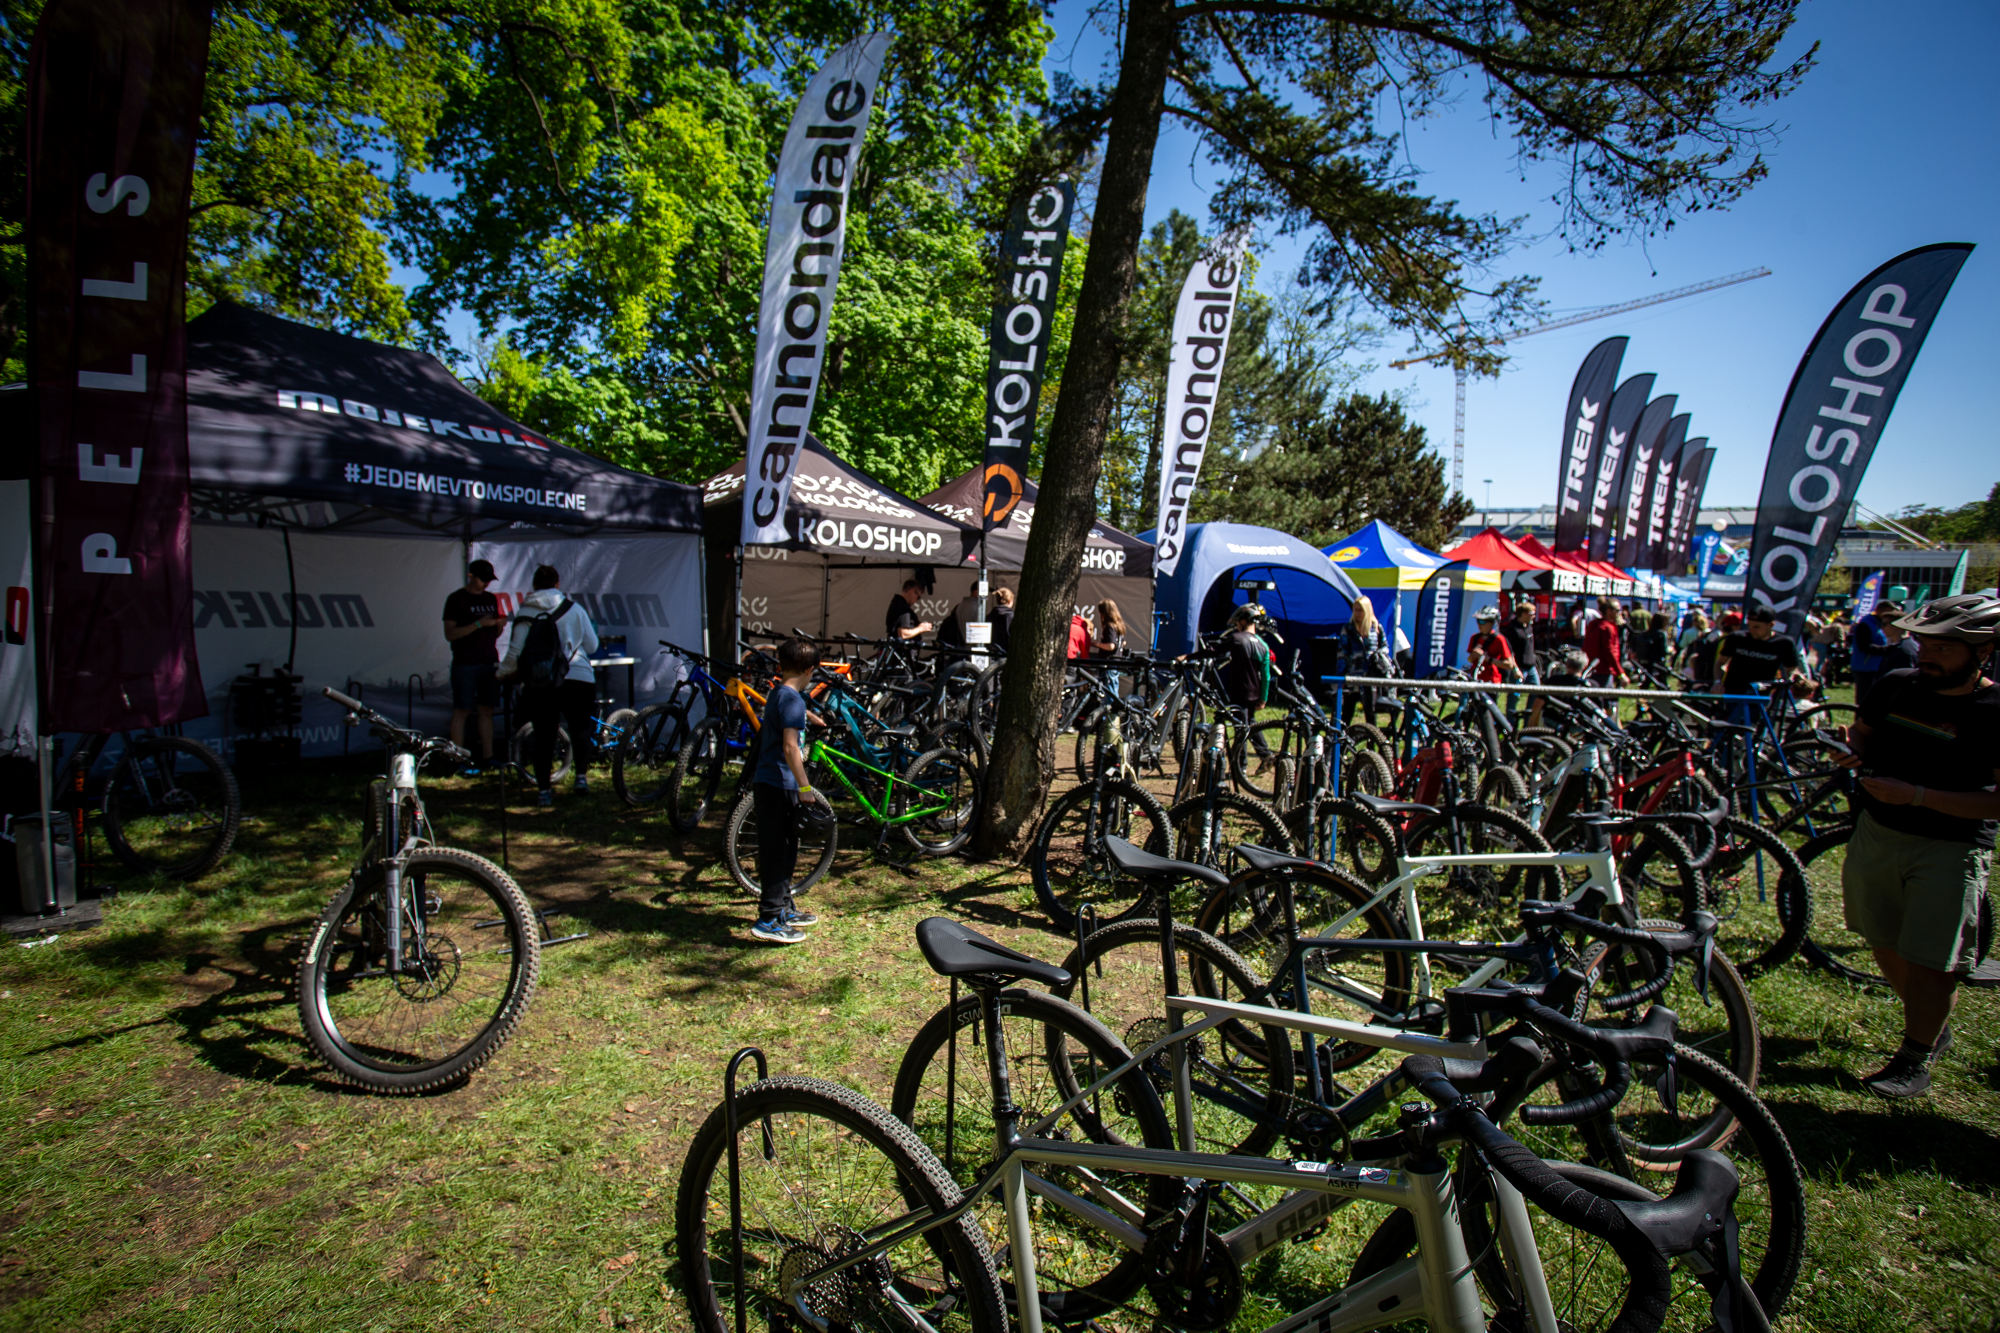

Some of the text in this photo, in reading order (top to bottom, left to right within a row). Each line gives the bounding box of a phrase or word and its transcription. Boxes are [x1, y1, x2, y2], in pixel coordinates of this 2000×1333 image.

[751, 77, 865, 528] cannondale
[78, 172, 151, 575] PELLS
[1157, 256, 1238, 562] cannondale
[344, 461, 587, 512] #JEDEMEVTOMSPOLECNE
[1560, 396, 1600, 516] TREK
[1591, 425, 1626, 528] TREK
[1622, 443, 1653, 541] TREK
[1647, 458, 1673, 546] TREK
[797, 517, 942, 556] KOLOSHOP
[1429, 576, 1450, 667] SHIMANO
[1327, 1179, 1361, 1191] ASKET
